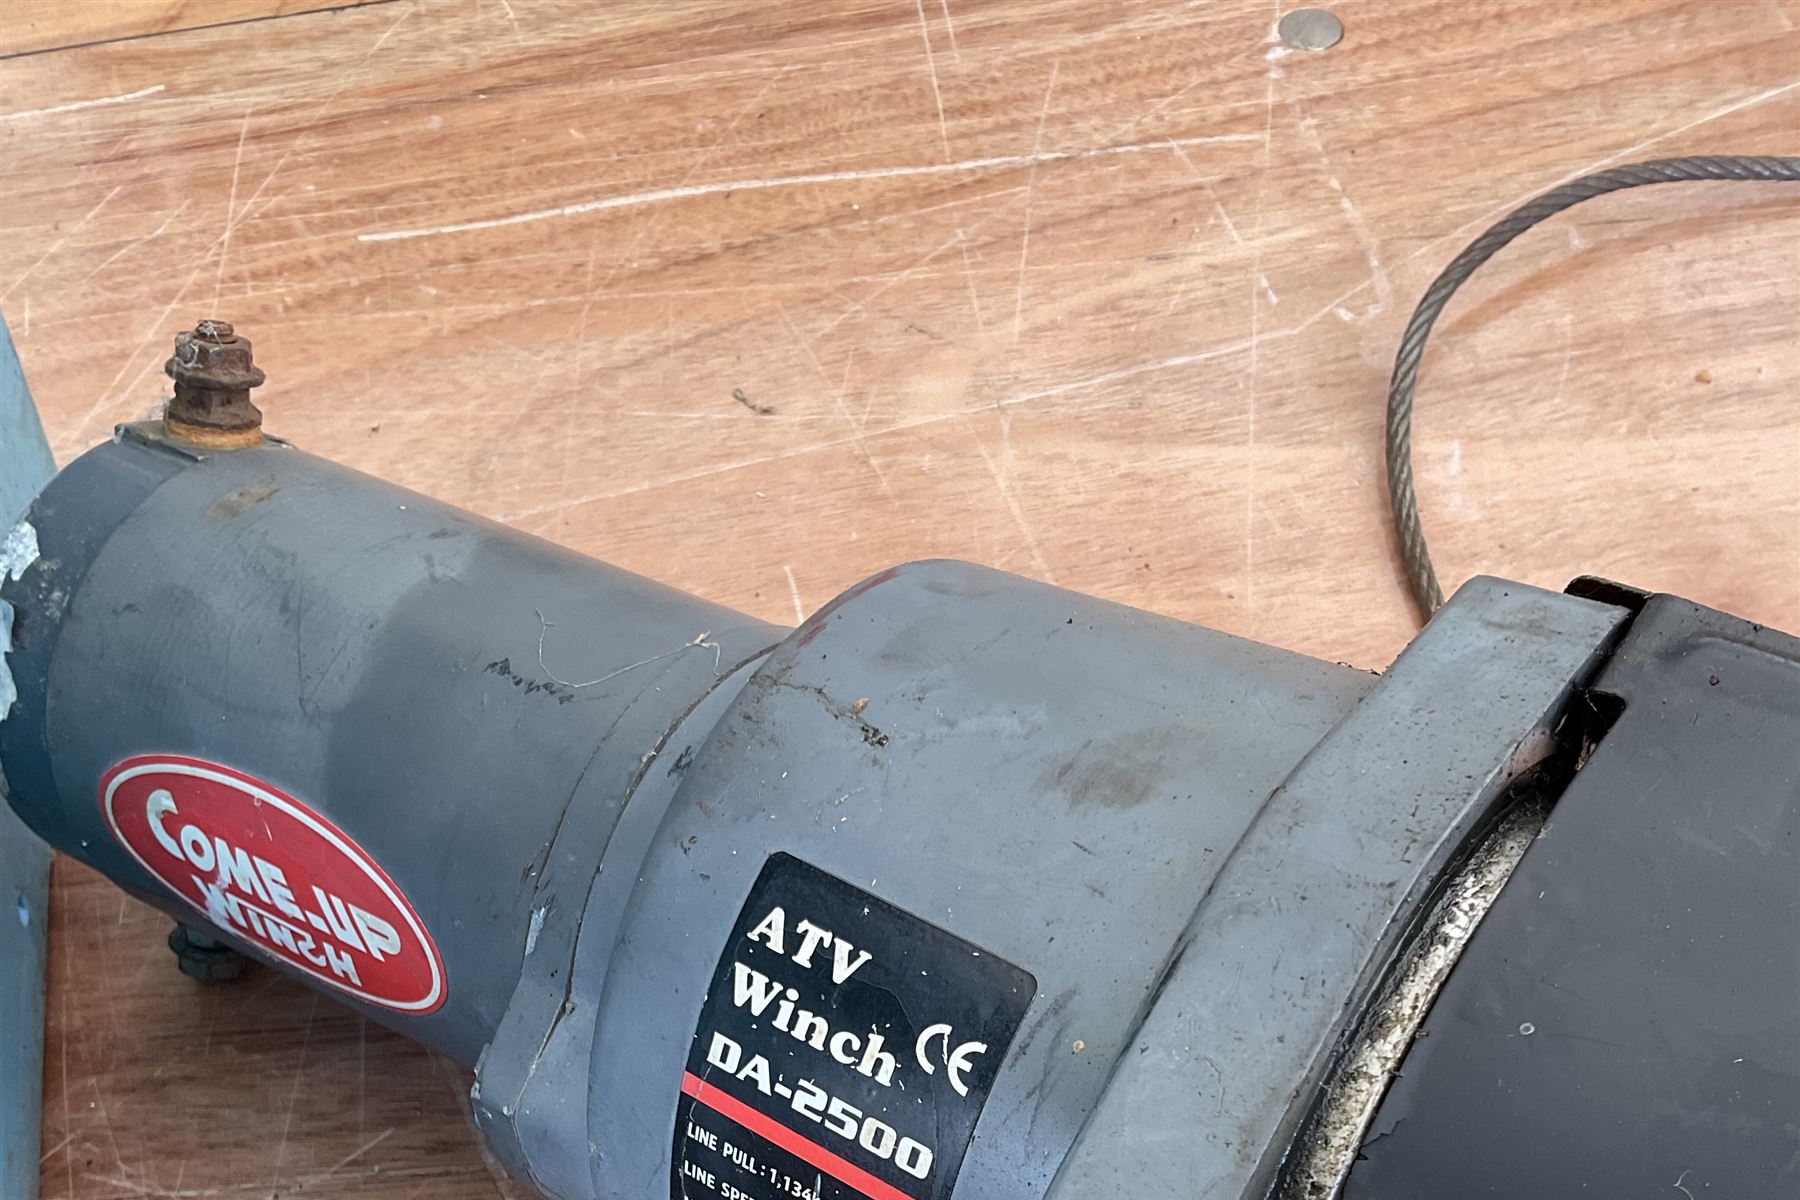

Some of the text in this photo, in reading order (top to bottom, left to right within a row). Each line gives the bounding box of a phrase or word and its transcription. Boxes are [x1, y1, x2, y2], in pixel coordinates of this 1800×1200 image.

[746, 906, 873, 985] ATV
[733, 961, 899, 1087] Winch
[915, 1022, 988, 1098] CE
[687, 1121, 718, 1152] LINE
[706, 1031, 934, 1180] DA-2500
[684, 1159, 716, 1190] LINE
